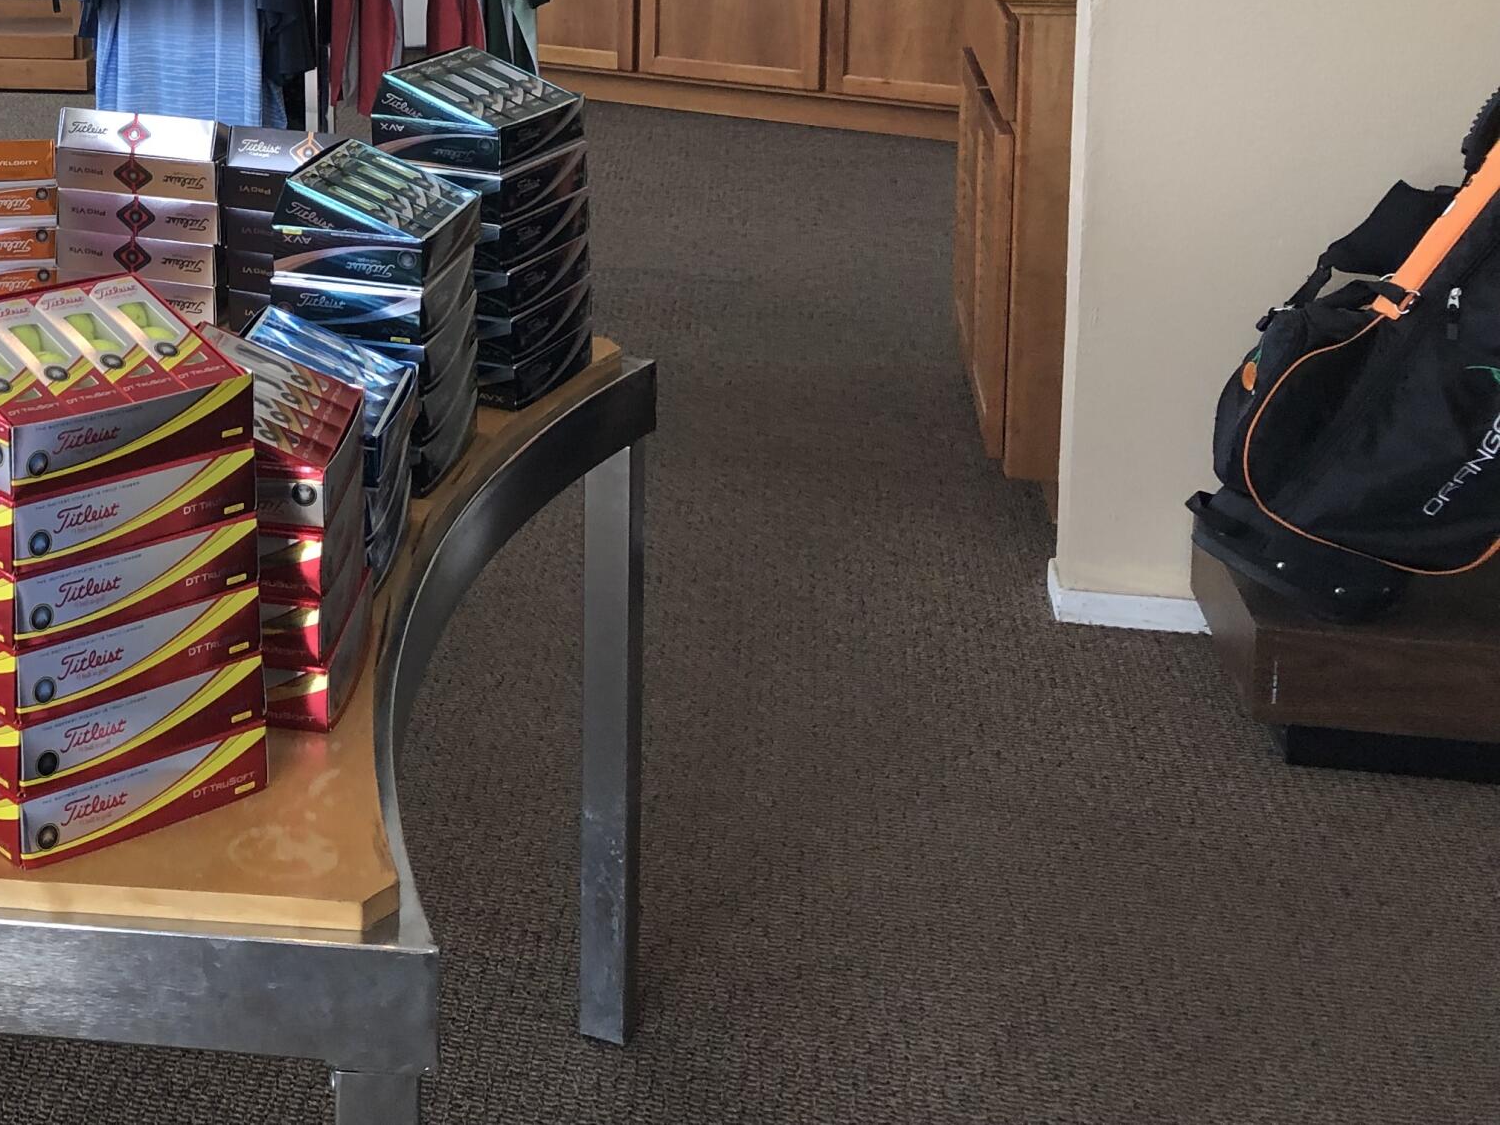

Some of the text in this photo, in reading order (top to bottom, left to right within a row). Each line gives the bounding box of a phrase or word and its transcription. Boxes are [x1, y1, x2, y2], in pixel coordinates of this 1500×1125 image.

[381, 92, 422, 118] Titleist
[69, 121, 109, 135] Titleist
[380, 122, 404, 132] AVX
[238, 138, 281, 154] Titleist
[163, 174, 207, 191] Titleist
[165, 216, 210, 232] Titleist
[286, 201, 334, 230] Titleist
[283, 234, 312, 245] AVX
[161, 257, 205, 274] Titleist
[345, 261, 395, 278] Titleist
[94, 284, 138, 300] Titleist
[41, 296, 85, 311] Titleist
[297, 292, 346, 310] Titleist
[52, 426, 122, 455] Titleist
[53, 503, 120, 534] Titleist
[55, 575, 123, 608] Titleist
[58, 648, 125, 681] Titleist
[60, 718, 127, 753] Titleist
[193, 787, 208, 799] DT
[61, 791, 128, 825] Titleist
